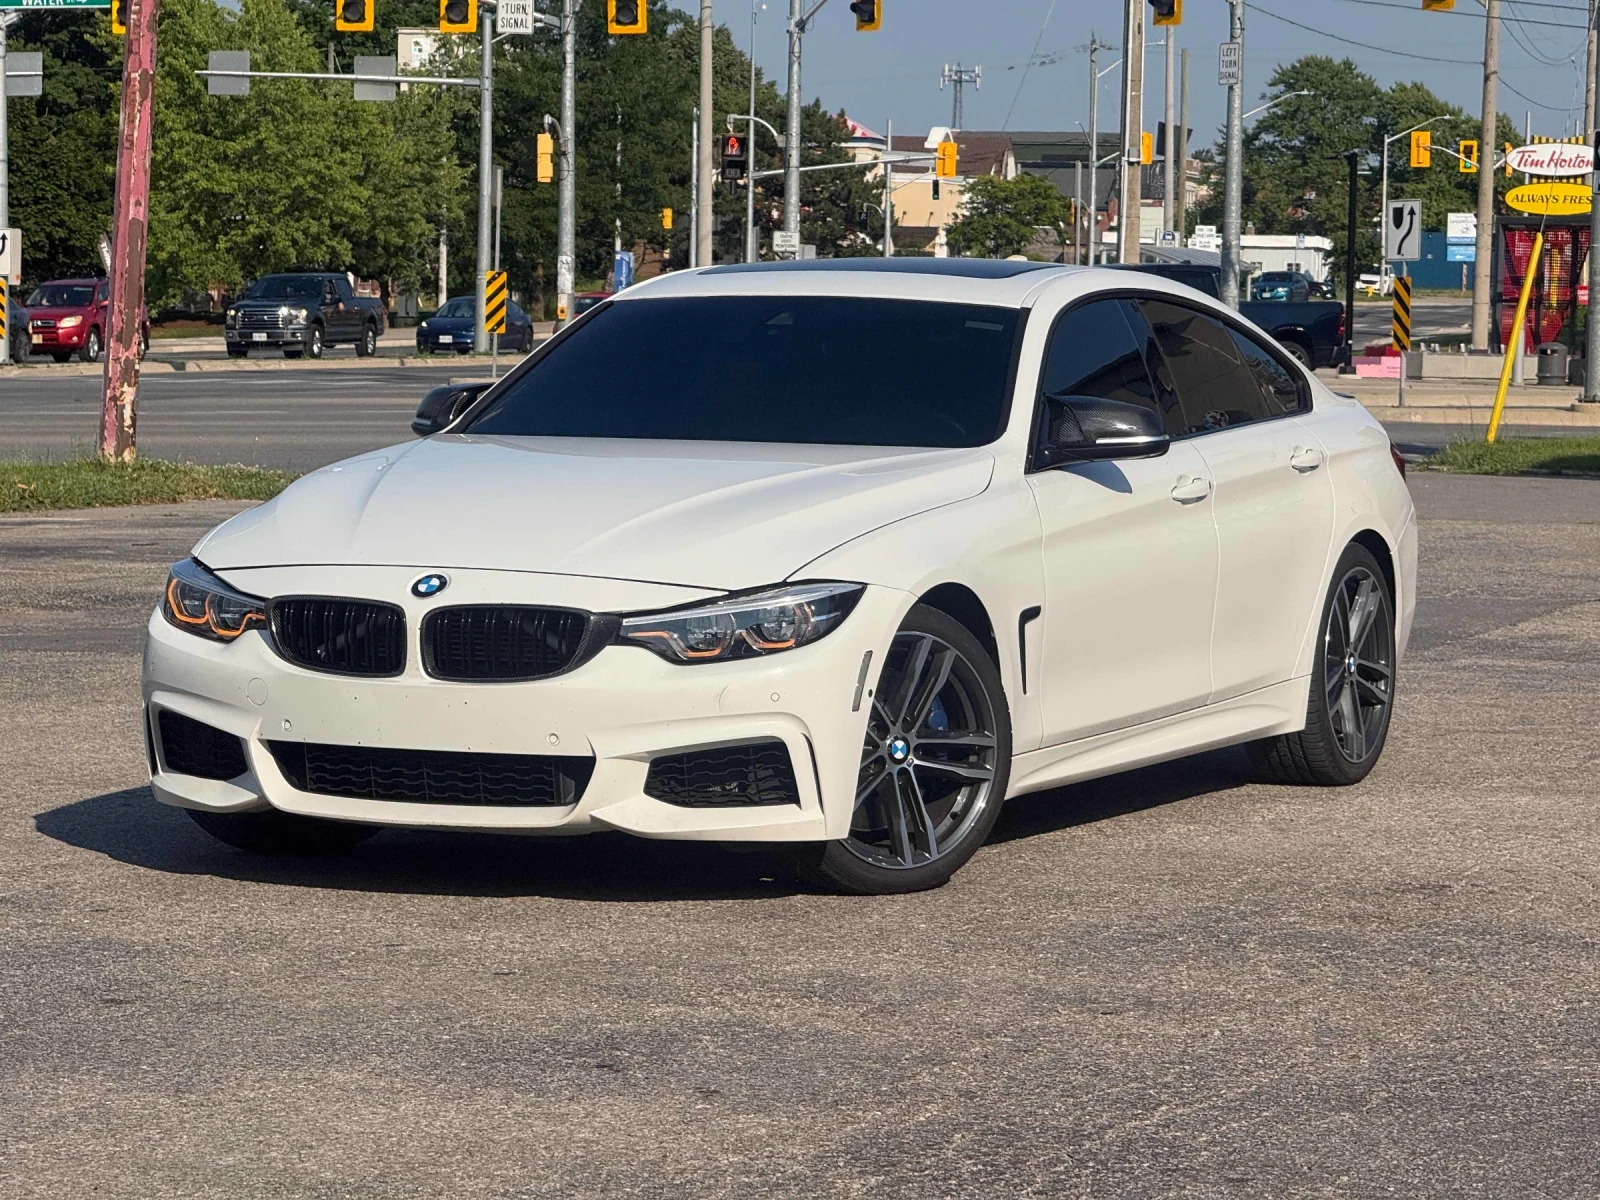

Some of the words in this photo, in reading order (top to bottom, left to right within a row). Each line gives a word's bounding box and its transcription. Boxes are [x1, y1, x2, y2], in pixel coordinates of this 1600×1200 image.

[504, 3, 528, 15] TURN
[500, 16, 529, 29] SIGNAL
[1222, 48, 1236, 56] LEFT
[1222, 60, 1236, 68] TURN
[1219, 71, 1238, 80] SIGNAL
[1516, 149, 1545, 169] Tim
[1511, 193, 1559, 204] ALWAYS
